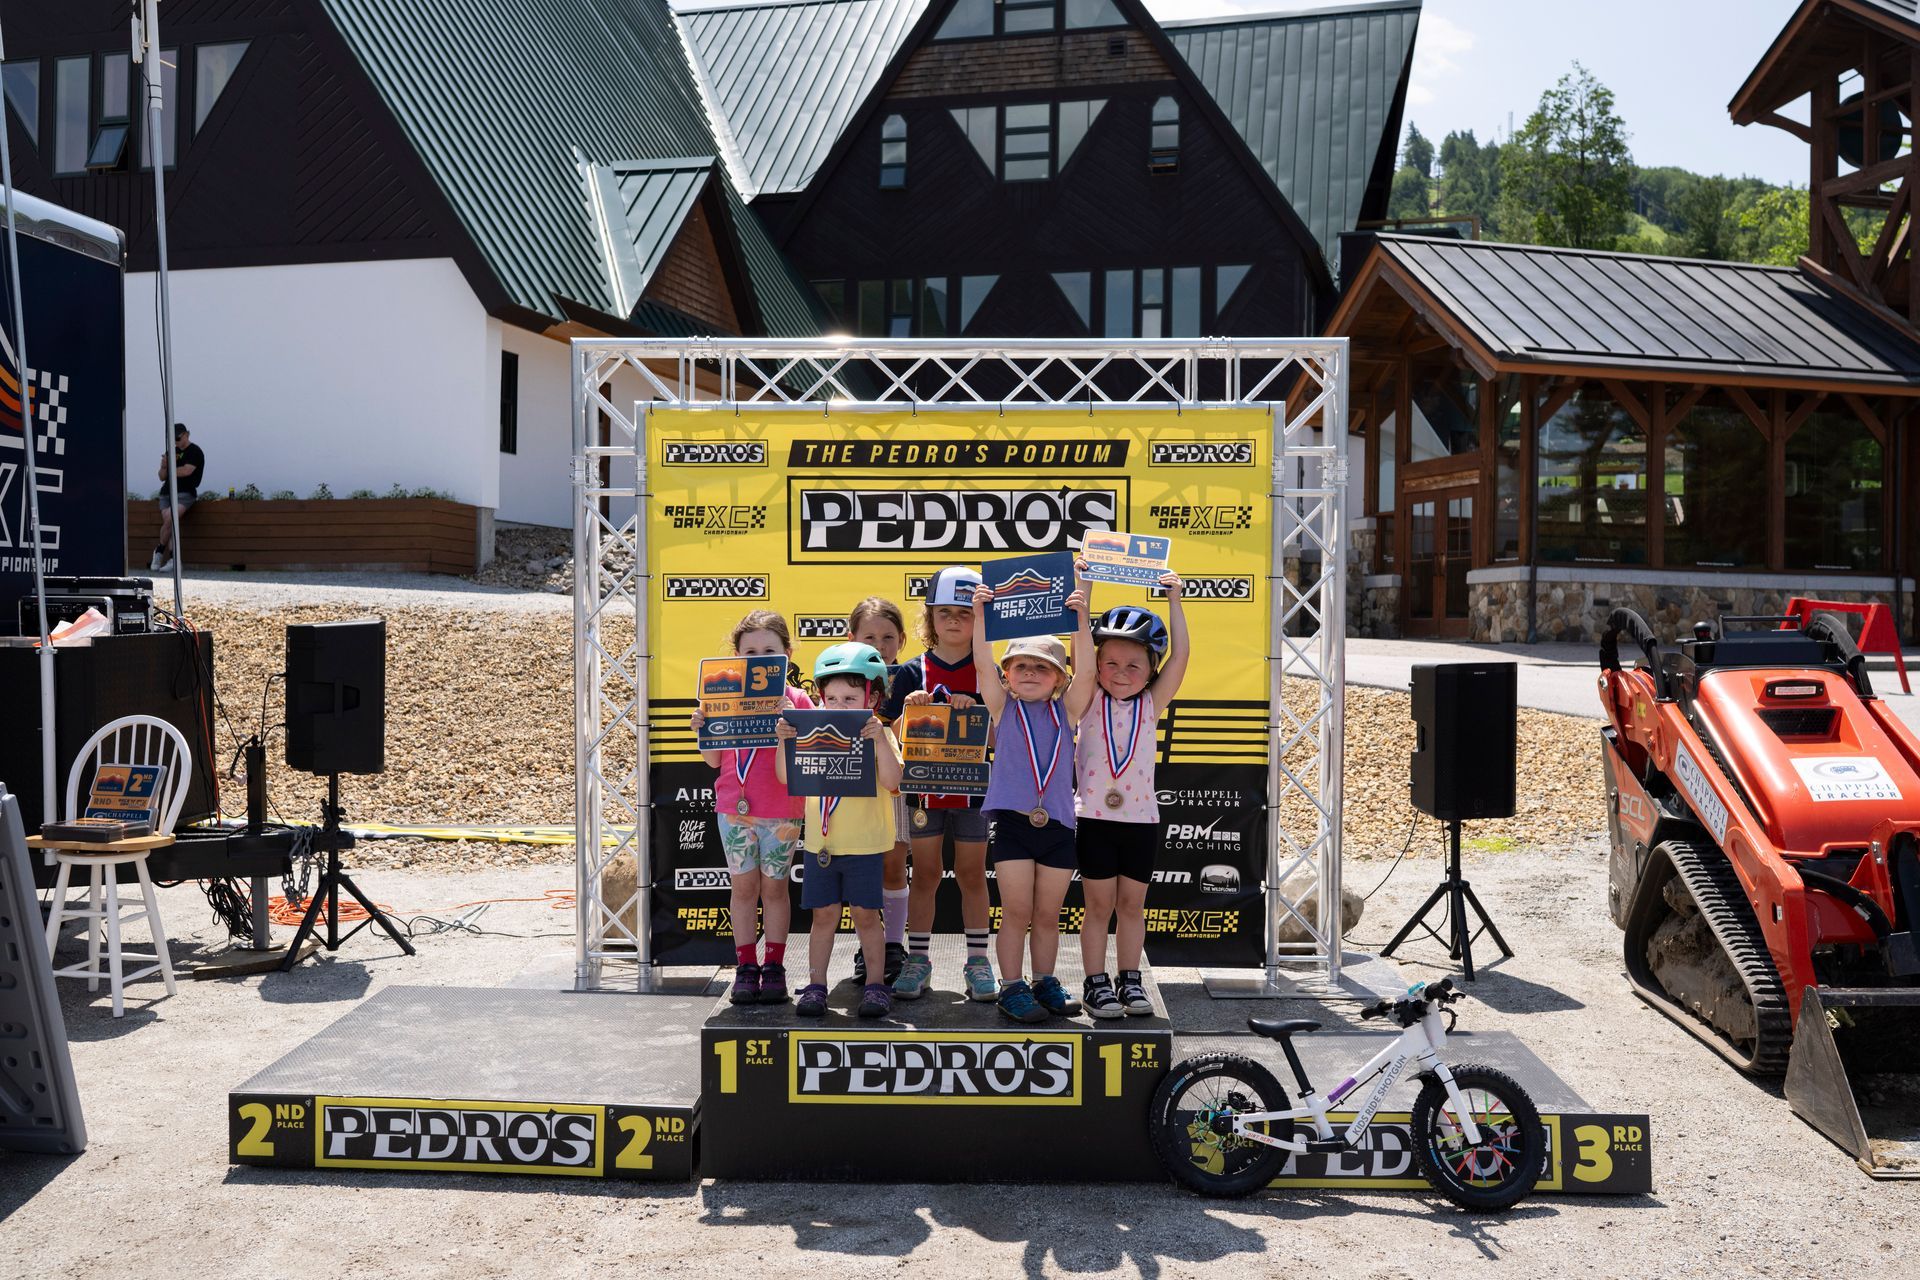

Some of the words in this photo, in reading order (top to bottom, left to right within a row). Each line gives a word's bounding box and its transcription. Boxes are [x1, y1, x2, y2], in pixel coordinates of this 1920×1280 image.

[666, 442, 764, 463] PEDRO'S
[805, 444, 855, 463] THE
[869, 444, 989, 463] PEDRO'S
[1004, 444, 1112, 463] PODIUM
[1153, 442, 1251, 463] PEDRO'S
[665, 505, 705, 516] RACE
[1150, 505, 1191, 517] RACE
[673, 517, 705, 529] DAY
[705, 505, 751, 529] XC
[1158, 517, 1190, 529] DAY
[1190, 505, 1237, 529] XC
[0, 556, 59, 573] PIONSHIP
[667, 576, 766, 597] PEDRO'S
[993, 598, 1027, 611] RACE
[1027, 595, 1063, 616] XC
[1000, 608, 1026, 619] DAY
[1025, 613, 1062, 621] CHAMPIONSHIP
[704, 702, 730, 713] RND
[731, 726, 777, 734] TRACTO
[906, 747, 931, 757] RND
[794, 756, 827, 765] RACE
[827, 756, 863, 775] XC
[802, 766, 826, 775] DAY
[930, 766, 980, 775] CHAPPELL
[931, 773, 979, 781] TRACTOR
[1810, 783, 1896, 791] CHAPPELL
[676, 788, 717, 801] AIR
[1178, 789, 1242, 799] CHAPPELL
[1690, 767, 1726, 827] CHAPPELL
[1816, 792, 1898, 800] TRACTOR
[1180, 799, 1240, 807] TRACTOR
[1620, 792, 1646, 821] SCL
[107, 811, 143, 819] CHAPPELL
[1690, 782, 1724, 838] TRACTOR
[679, 820, 706, 832] CYCLE
[1166, 819, 1219, 840] PBM
[679, 830, 705, 843] CRAFT
[679, 842, 704, 850] FITNESS
[1165, 841, 1241, 851] COACHING
[677, 907, 719, 919] RACE
[686, 919, 717, 930] DAY
[1146, 920, 1178, 932] DAY
[1178, 910, 1223, 932] XC
[745, 1057, 774, 1065] PLACE
[799, 1038, 1073, 1095] PEDRO'S
[1352, 1114, 1369, 1136] KIDS
[1367, 1095, 1381, 1117] RIDE
[1377, 1054, 1408, 1097] SHOTGUN
[277, 1121, 305, 1129] PLACE
[325, 1106, 595, 1167] PEDRO'S
[656, 1134, 684, 1142] PLACE
[1614, 1144, 1643, 1152] PLACE
